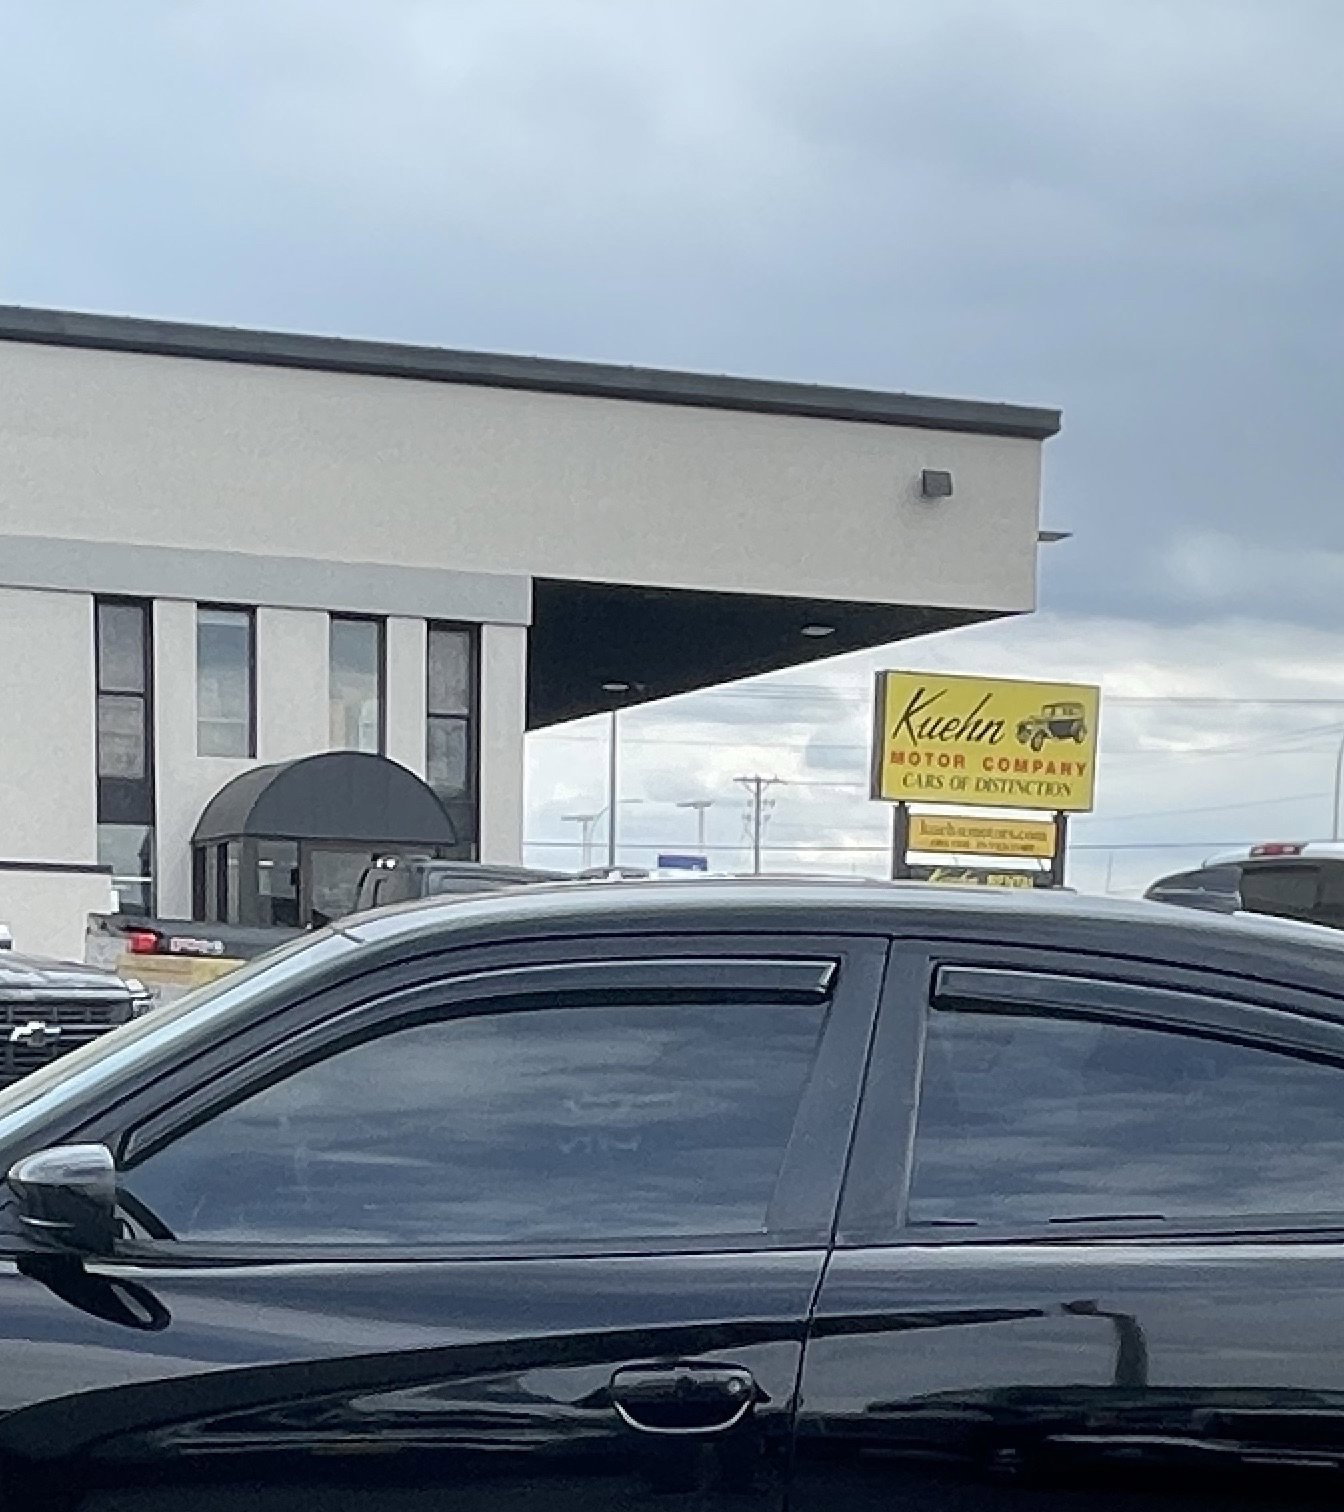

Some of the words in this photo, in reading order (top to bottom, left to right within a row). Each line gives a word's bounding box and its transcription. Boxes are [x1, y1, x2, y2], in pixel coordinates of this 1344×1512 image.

[892, 687, 1005, 747] Kuehn
[890, 751, 965, 769] MOTOR
[982, 756, 1086, 777] COMPANY
[903, 772, 944, 789] CARS
[949, 775, 969, 792] OF
[974, 777, 1072, 797] DISTINCTION
